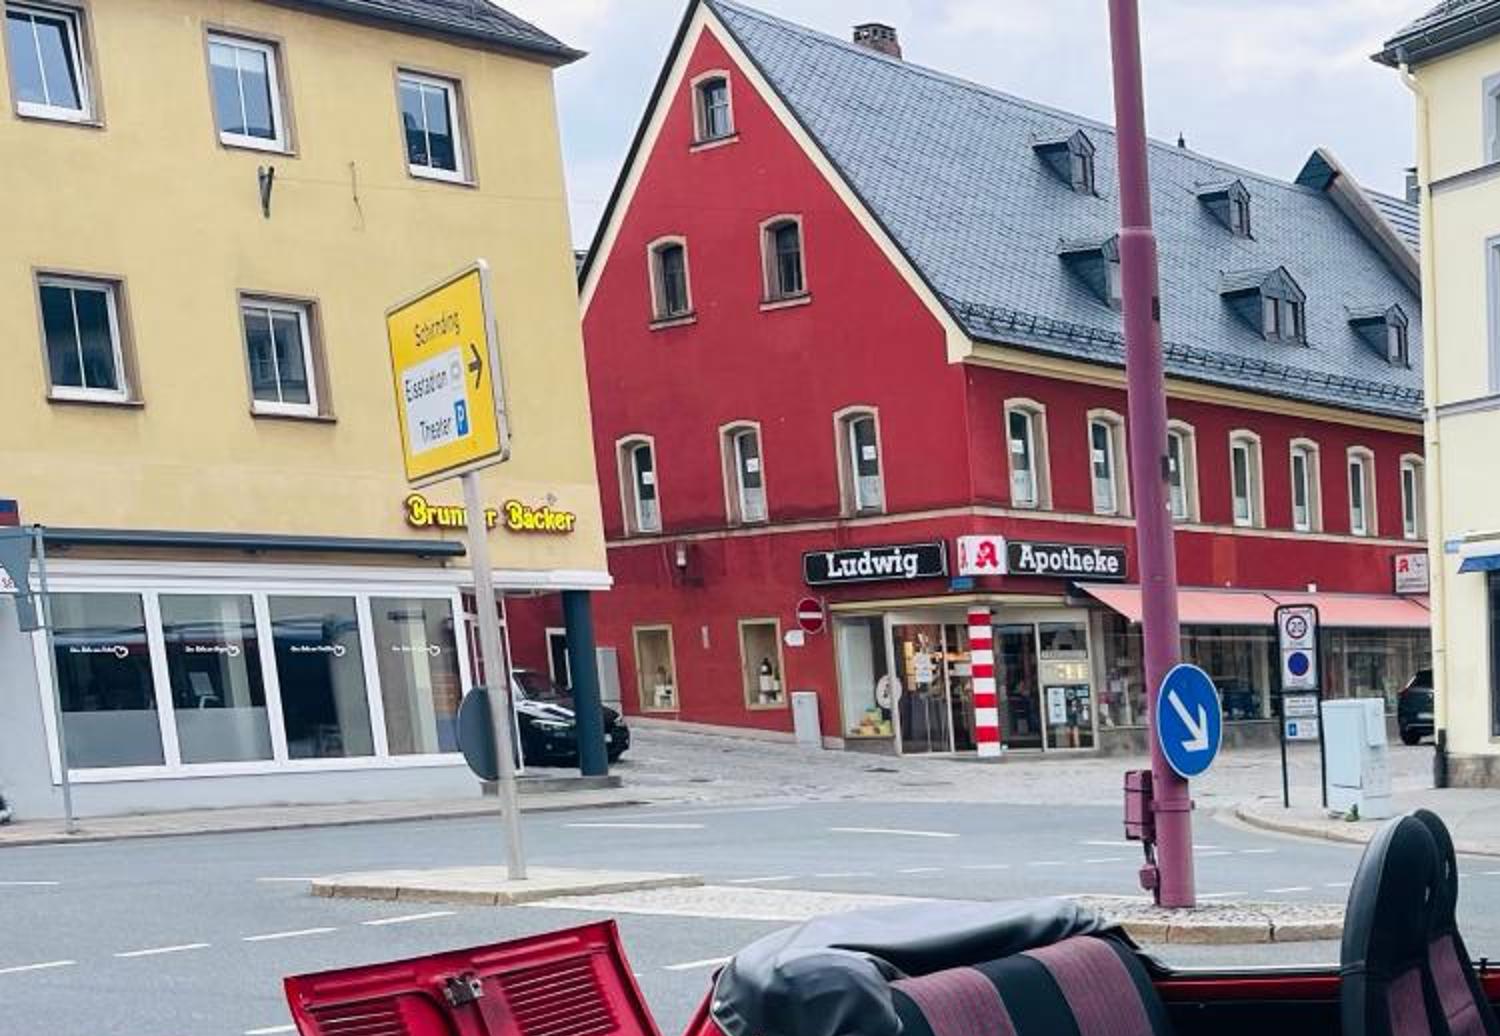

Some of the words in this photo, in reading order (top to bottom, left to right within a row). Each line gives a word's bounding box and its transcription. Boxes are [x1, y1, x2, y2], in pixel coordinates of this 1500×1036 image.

[415, 312, 460, 346] Schirnding
[404, 369, 448, 402] Eisstadion
[419, 416, 452, 444] Theater
[407, 493, 498, 529] Brunr
[505, 500, 576, 531] Bäcker
[826, 549, 919, 578] Ludwig
[1018, 545, 1120, 573] Apotheke
